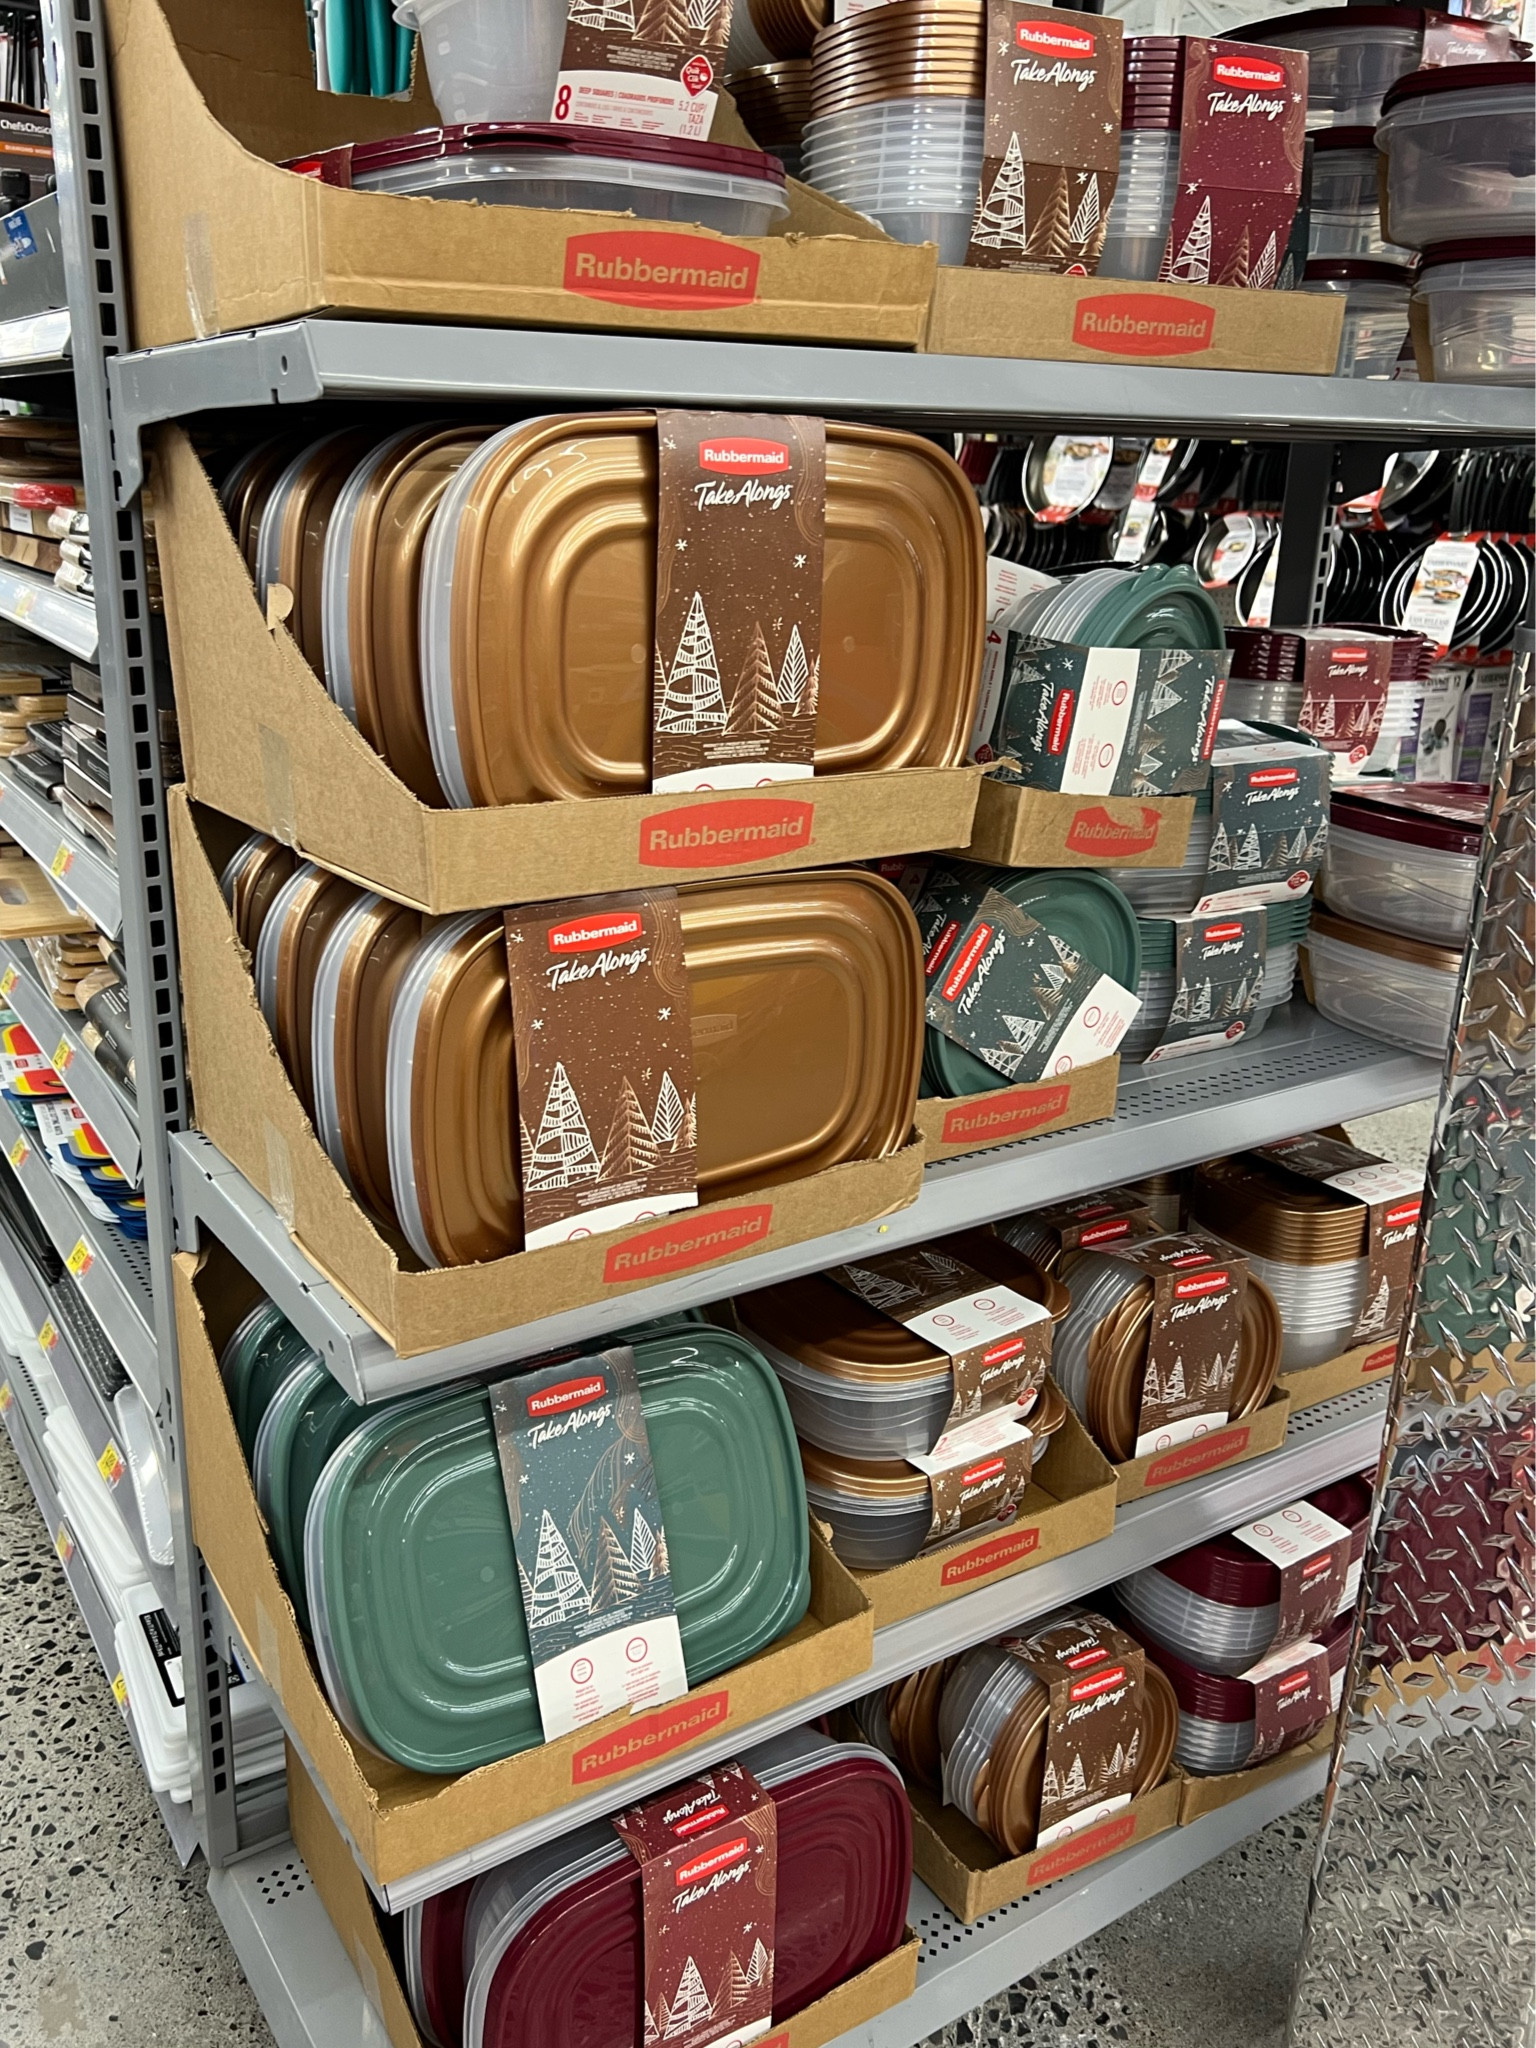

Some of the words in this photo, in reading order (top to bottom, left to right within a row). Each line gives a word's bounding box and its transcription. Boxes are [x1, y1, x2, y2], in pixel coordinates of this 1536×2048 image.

[1020, 29, 1090, 50] Rubbermaid
[1010, 58, 1098, 93] TakeAlongs
[1217, 64, 1281, 83] Rubbermaid
[555, 85, 572, 120] 8
[1207, 92, 1286, 121] TakeAlongs
[575, 252, 749, 289] Rubbermaid
[1081, 311, 1207, 338] Rubbermaid
[704, 449, 784, 464] Rubbermaid
[694, 479, 793, 512] TakeAlongs
[986, 629, 1002, 645] 4
[1031, 682, 1054, 753] TakeAlongs
[1051, 692, 1071, 752] Rubbermaid
[1245, 787, 1300, 806] TakeAlongs
[650, 816, 804, 851] Rubbermaid
[1073, 821, 1157, 839] Rubbermaid
[1200, 898, 1213, 911] 6
[553, 920, 638, 945] Rubbermaid
[546, 947, 650, 992] TakeAlongs
[947, 927, 989, 997] Rubbermaid
[957, 929, 1006, 1015] TakeAlongs
[1150, 1048, 1165, 1061] 6
[951, 1094, 1064, 1133] Rubbermaid
[614, 1216, 763, 1271] Rubbermaid
[1081, 1224, 1128, 1243] Rubbermaid
[1382, 1224, 1417, 1249] TakeAlo
[1177, 1276, 1227, 1294] Rubbermaid
[1170, 1293, 1230, 1323] TakeAlongs
[531, 1382, 601, 1411] Rubbermaid
[527, 1404, 613, 1449] TakeAlongs
[1152, 1434, 1245, 1478] Rubbermaid
[946, 1535, 1035, 1579] Rubbermaid
[1073, 1671, 1123, 1697] Rubbermaid
[1066, 1686, 1128, 1725] TakeAlongs
[581, 1701, 721, 1773] Rubbermaid
[679, 1842, 744, 1881] Rubbermaid
[672, 1860, 752, 1914] TakeAlongs
